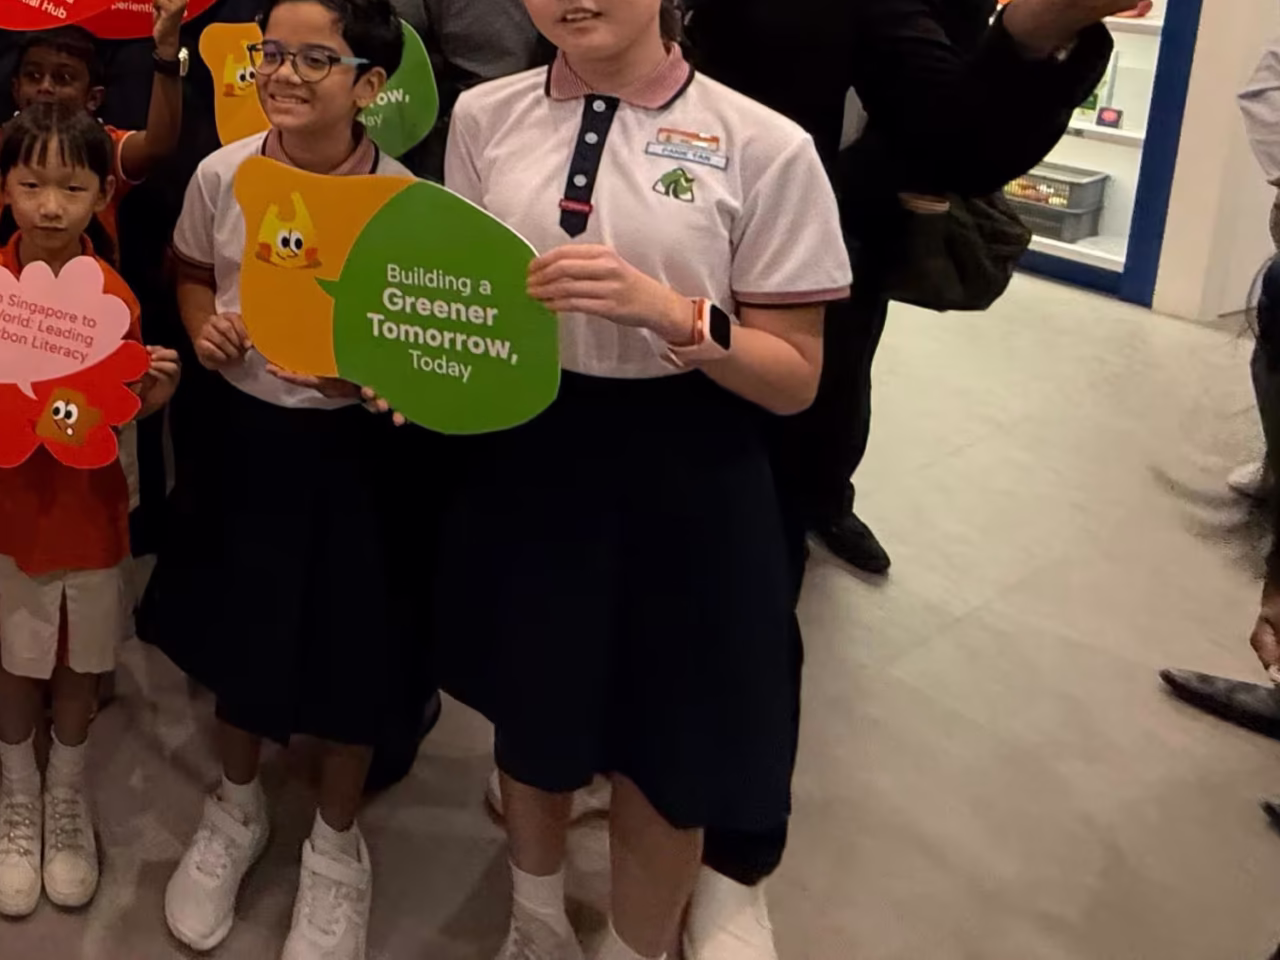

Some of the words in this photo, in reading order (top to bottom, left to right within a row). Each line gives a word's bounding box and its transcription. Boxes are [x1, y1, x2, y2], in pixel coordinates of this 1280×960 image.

[41, 0, 67, 19] Hub
[387, 263, 471, 296] Building
[479, 279, 491, 295] a
[7, 294, 78, 324] Singapore
[82, 315, 97, 329] to
[382, 287, 499, 327] Greener
[31, 336, 89, 365] Literacy
[37, 320, 94, 348] Leading
[367, 312, 519, 366] Tomorrow,
[408, 349, 472, 383] Today
